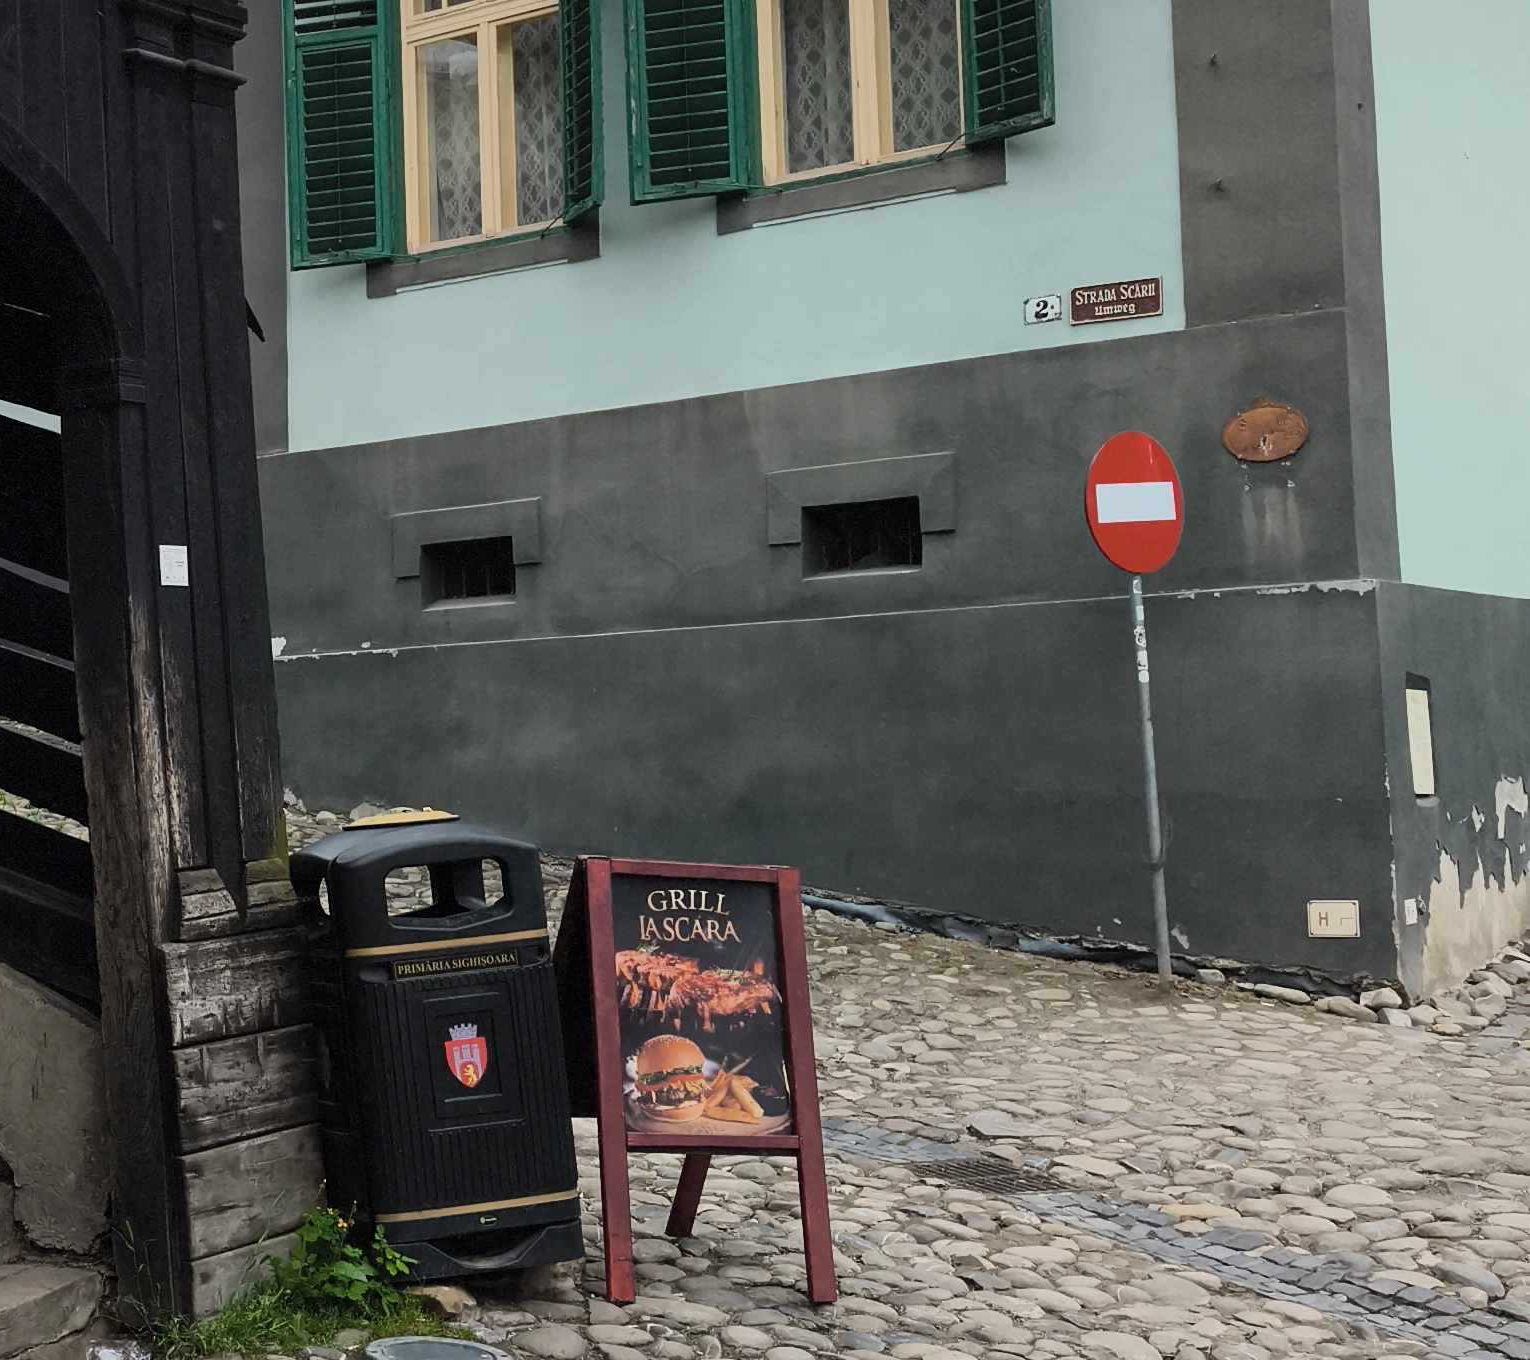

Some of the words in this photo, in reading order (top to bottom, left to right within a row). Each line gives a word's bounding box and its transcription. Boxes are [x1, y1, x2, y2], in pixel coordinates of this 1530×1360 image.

[1075, 290, 1117, 306] STRADA
[647, 889, 730, 916] GRILL
[1318, 911, 1328, 927] H
[398, 960, 451, 975] PRIMĂRIA
